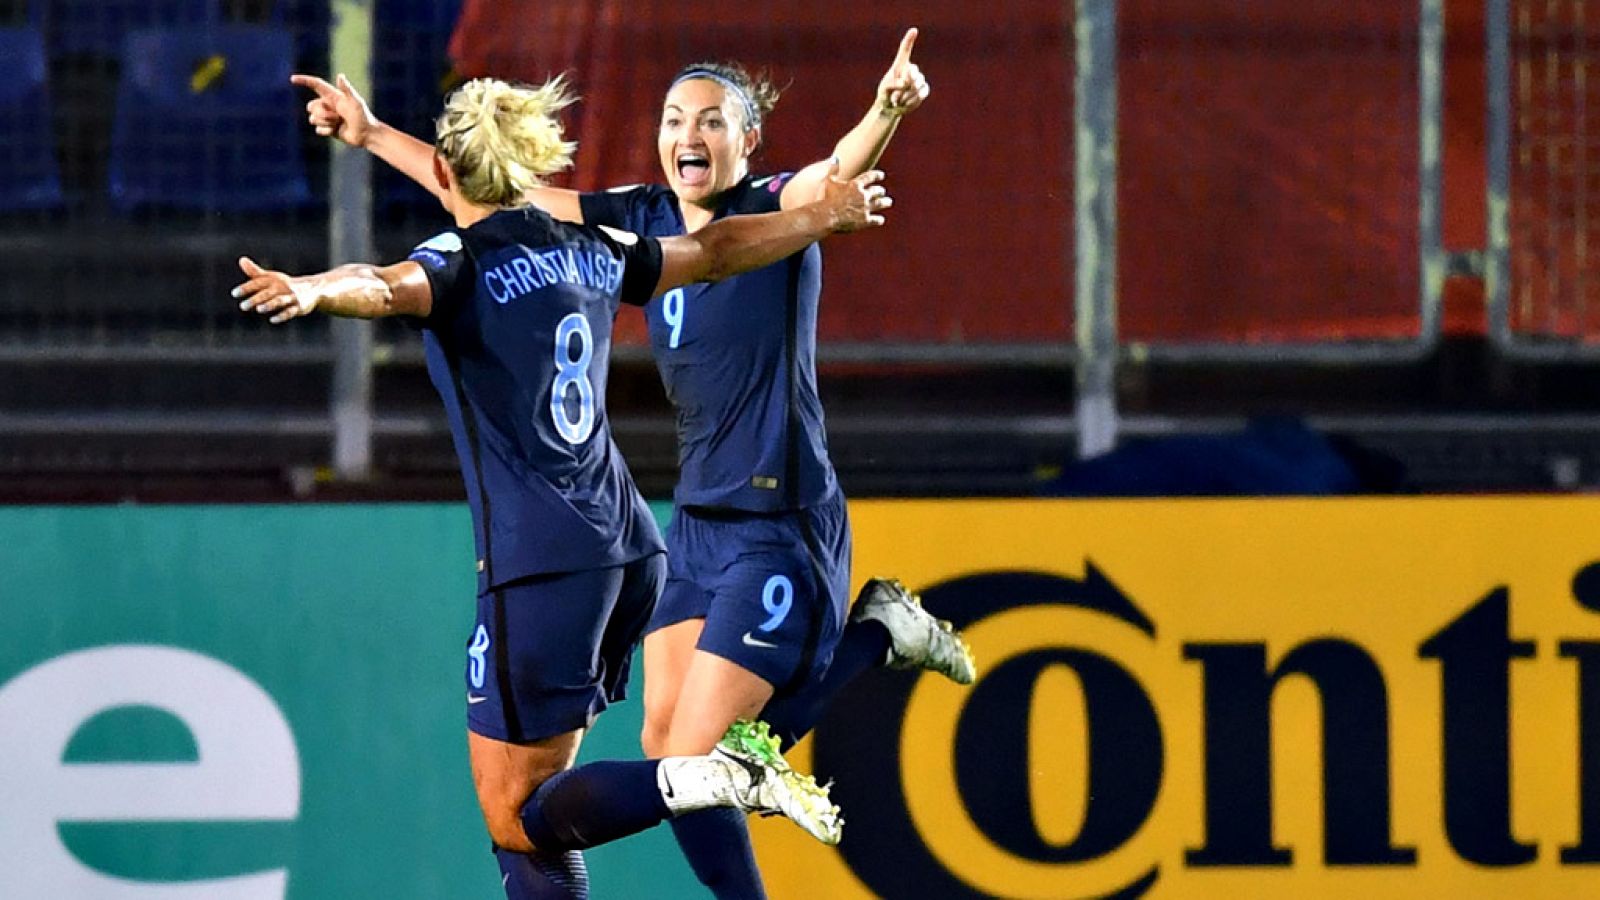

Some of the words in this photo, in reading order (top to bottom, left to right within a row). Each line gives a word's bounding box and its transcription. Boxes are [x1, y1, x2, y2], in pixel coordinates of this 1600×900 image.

[663, 287, 685, 348] 9
[550, 313, 595, 444] 8
[758, 575, 793, 632] 9
